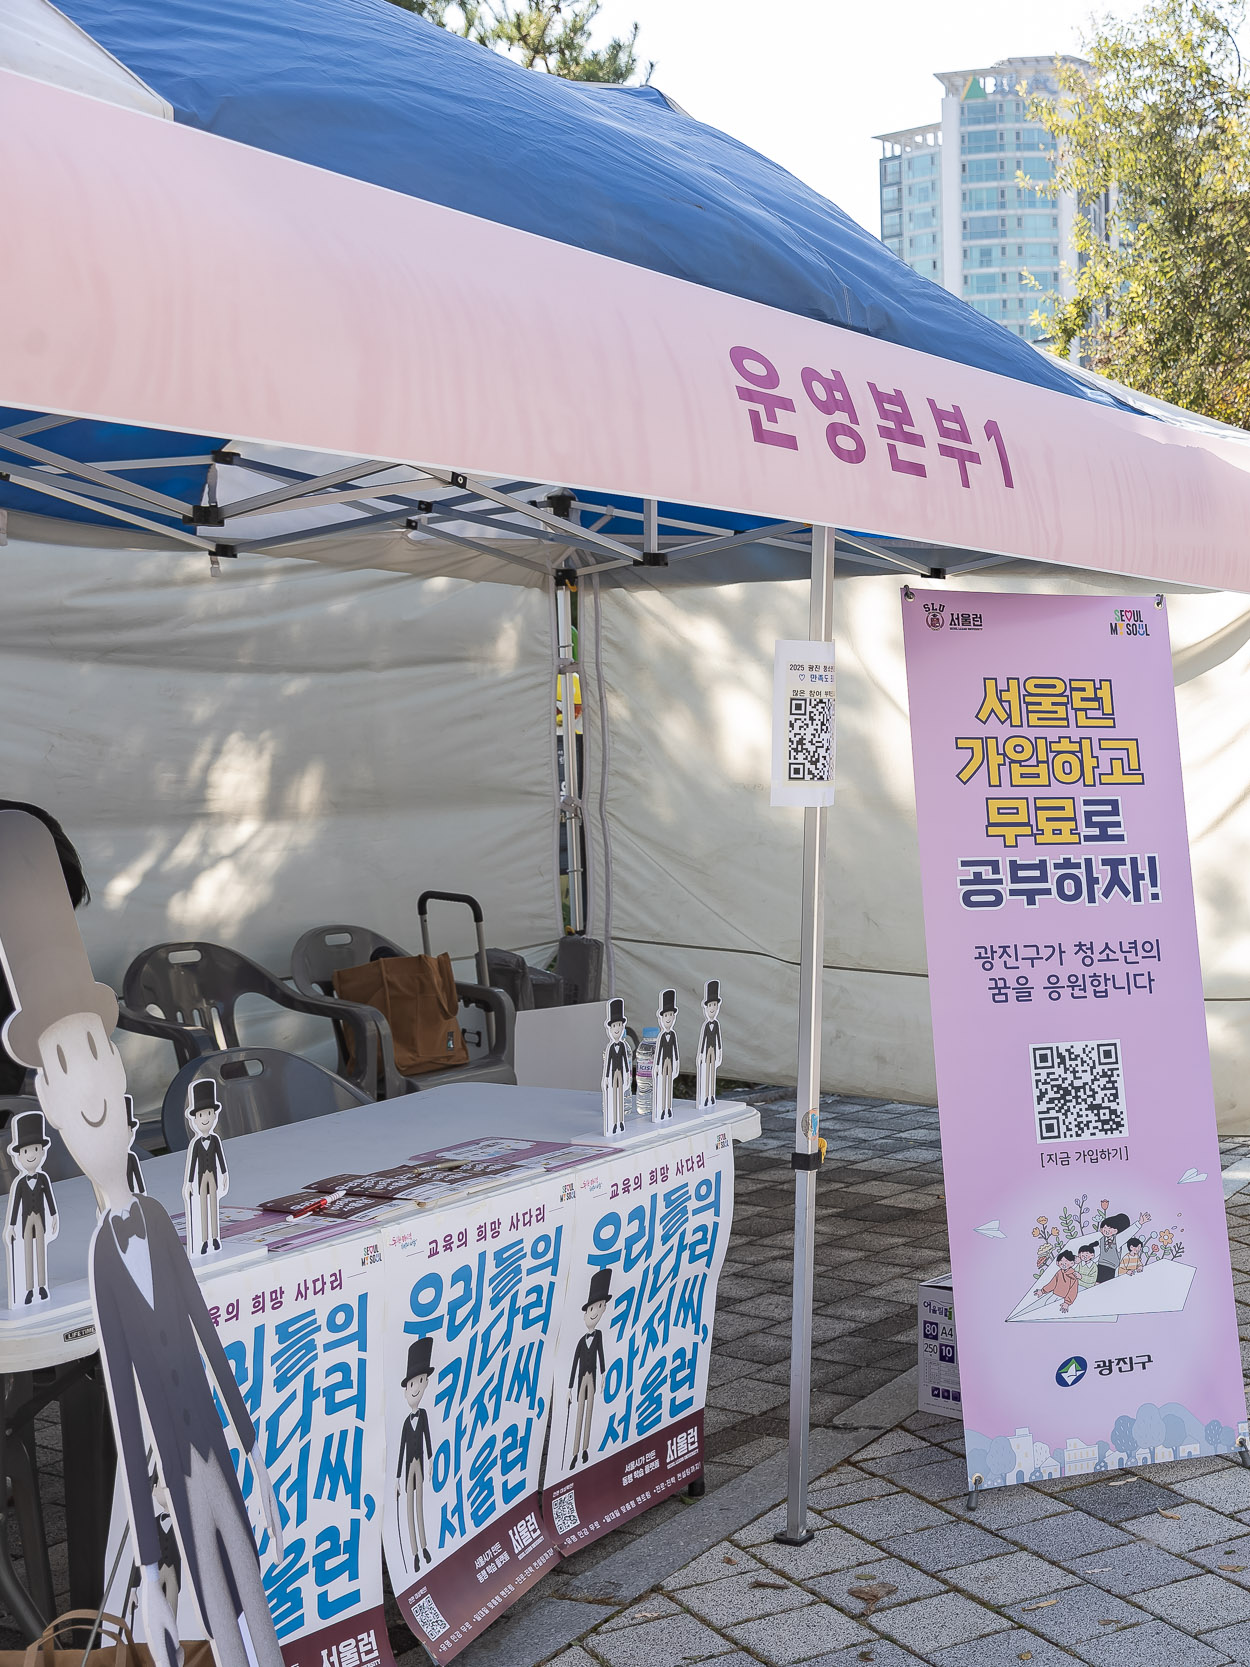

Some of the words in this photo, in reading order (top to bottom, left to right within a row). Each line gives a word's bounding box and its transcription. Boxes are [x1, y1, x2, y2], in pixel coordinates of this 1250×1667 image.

[729, 346, 1014, 489] 운영본부1
[923, 602, 945, 612] SLU
[949, 613, 983, 627] 서울런
[1126, 623, 1150, 636] SOUL
[808, 664, 820, 672] 광진
[974, 675, 1117, 729] 서울런
[955, 736, 1145, 788] 가입하고
[984, 796, 1127, 848] 무료로
[956, 853, 1163, 911] 공부하자!
[974, 942, 1066, 971] 광진구가
[1073, 939, 1161, 968] 청소년의
[988, 975, 1034, 1004] 꿈을
[1043, 971, 1155, 1001] 응원합니다
[610, 1172, 642, 1200] 교육의
[649, 1164, 669, 1185] 희망
[675, 1152, 706, 1177] 사다리
[1040, 1152, 1071, 1168] [지금
[1075, 1146, 1129, 1164] 가입하기]
[427, 1228, 467, 1259] 교육의
[476, 1218, 501, 1242] 희망
[509, 1204, 545, 1232] 사다리
[587, 1170, 721, 1273] 우리들의
[251, 1286, 284, 1315] 희망
[295, 1269, 343, 1301] 사다리
[403, 1224, 563, 1342] 우리들의
[610, 1221, 719, 1343] 키다리
[434, 1280, 555, 1423] 키다리
[603, 1271, 709, 1404] 아저씨,
[924, 1343, 938, 1354] 250
[925, 1323, 937, 1335] 80
[940, 1326, 953, 1338] A4
[941, 1346, 952, 1357] 10
[1094, 1354, 1153, 1377] 광진구
[432, 1339, 545, 1493] 아저씨,
[598, 1341, 699, 1452] 서울런
[666, 1426, 699, 1463] 서울런
[438, 1417, 533, 1549] 서울런
[508, 1512, 541, 1554] 서울런
